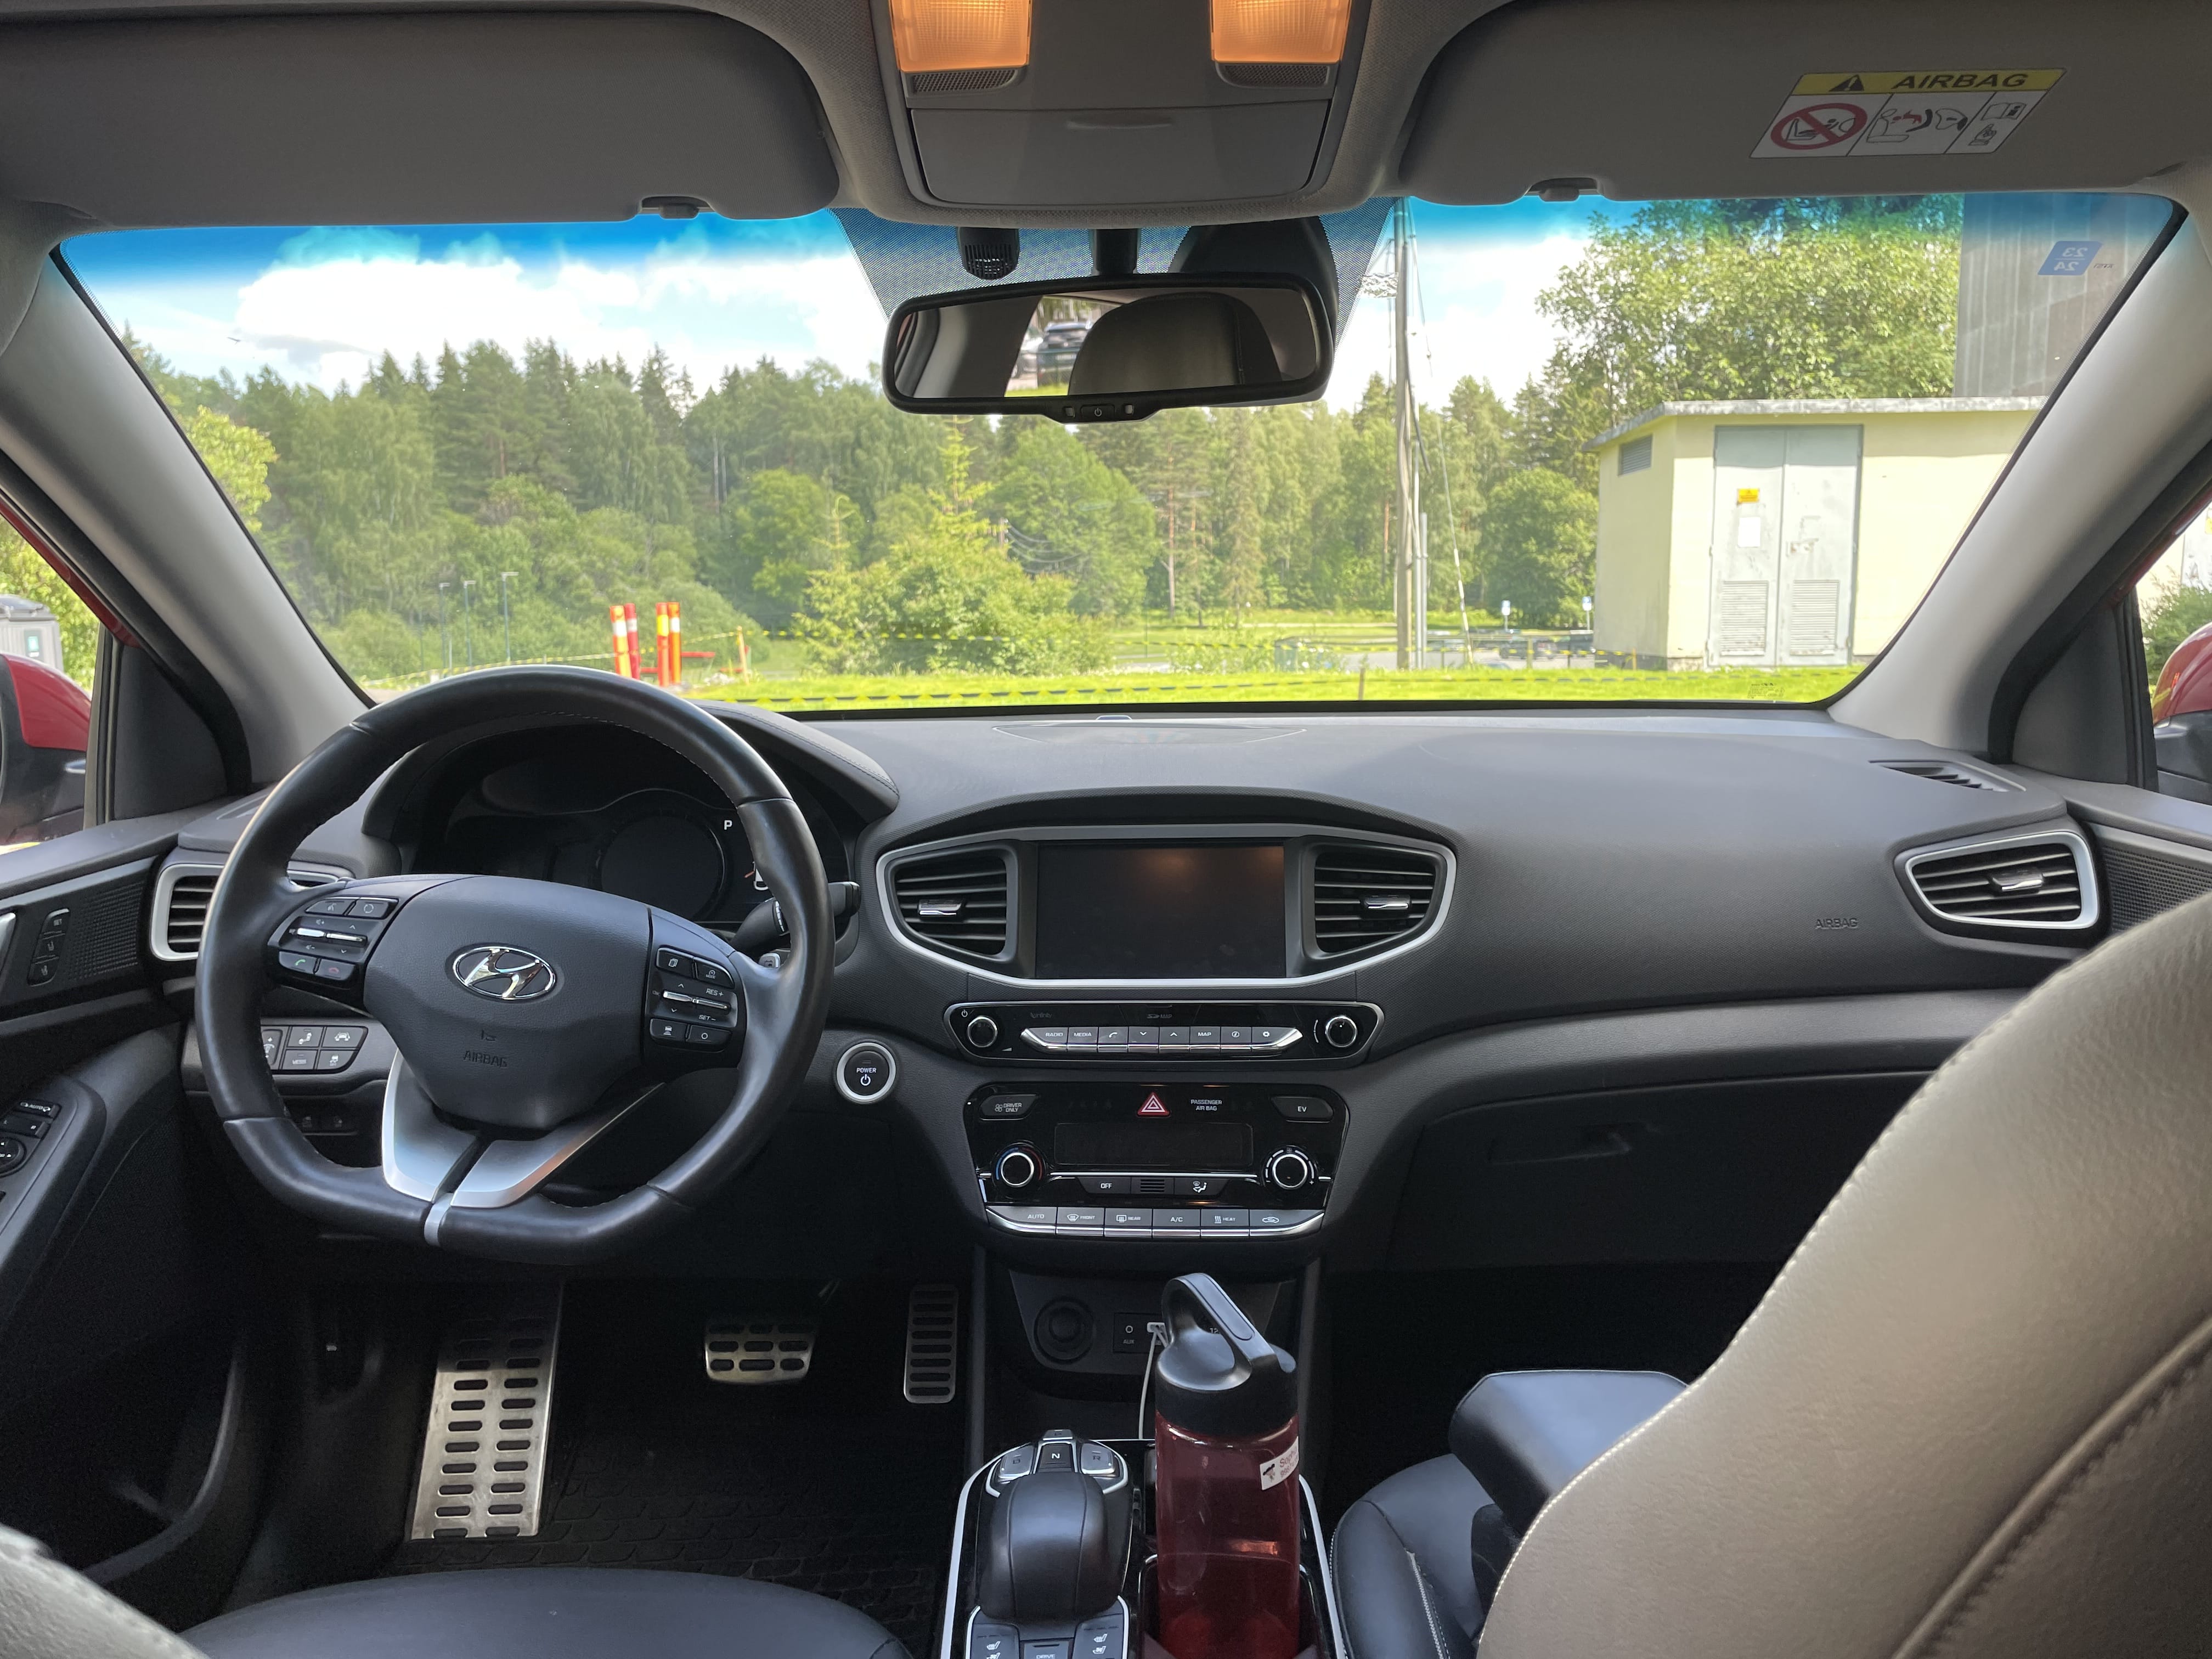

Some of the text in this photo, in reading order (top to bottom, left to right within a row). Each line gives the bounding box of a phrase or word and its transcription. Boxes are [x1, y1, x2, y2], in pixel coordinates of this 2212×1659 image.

[1891, 73, 2029, 89] AIRBAG
[724, 820, 733, 830] P
[1815, 917, 1858, 929] AIRBAG
[706, 988, 718, 996] RES
[462, 1049, 508, 1067] AIRBAG
